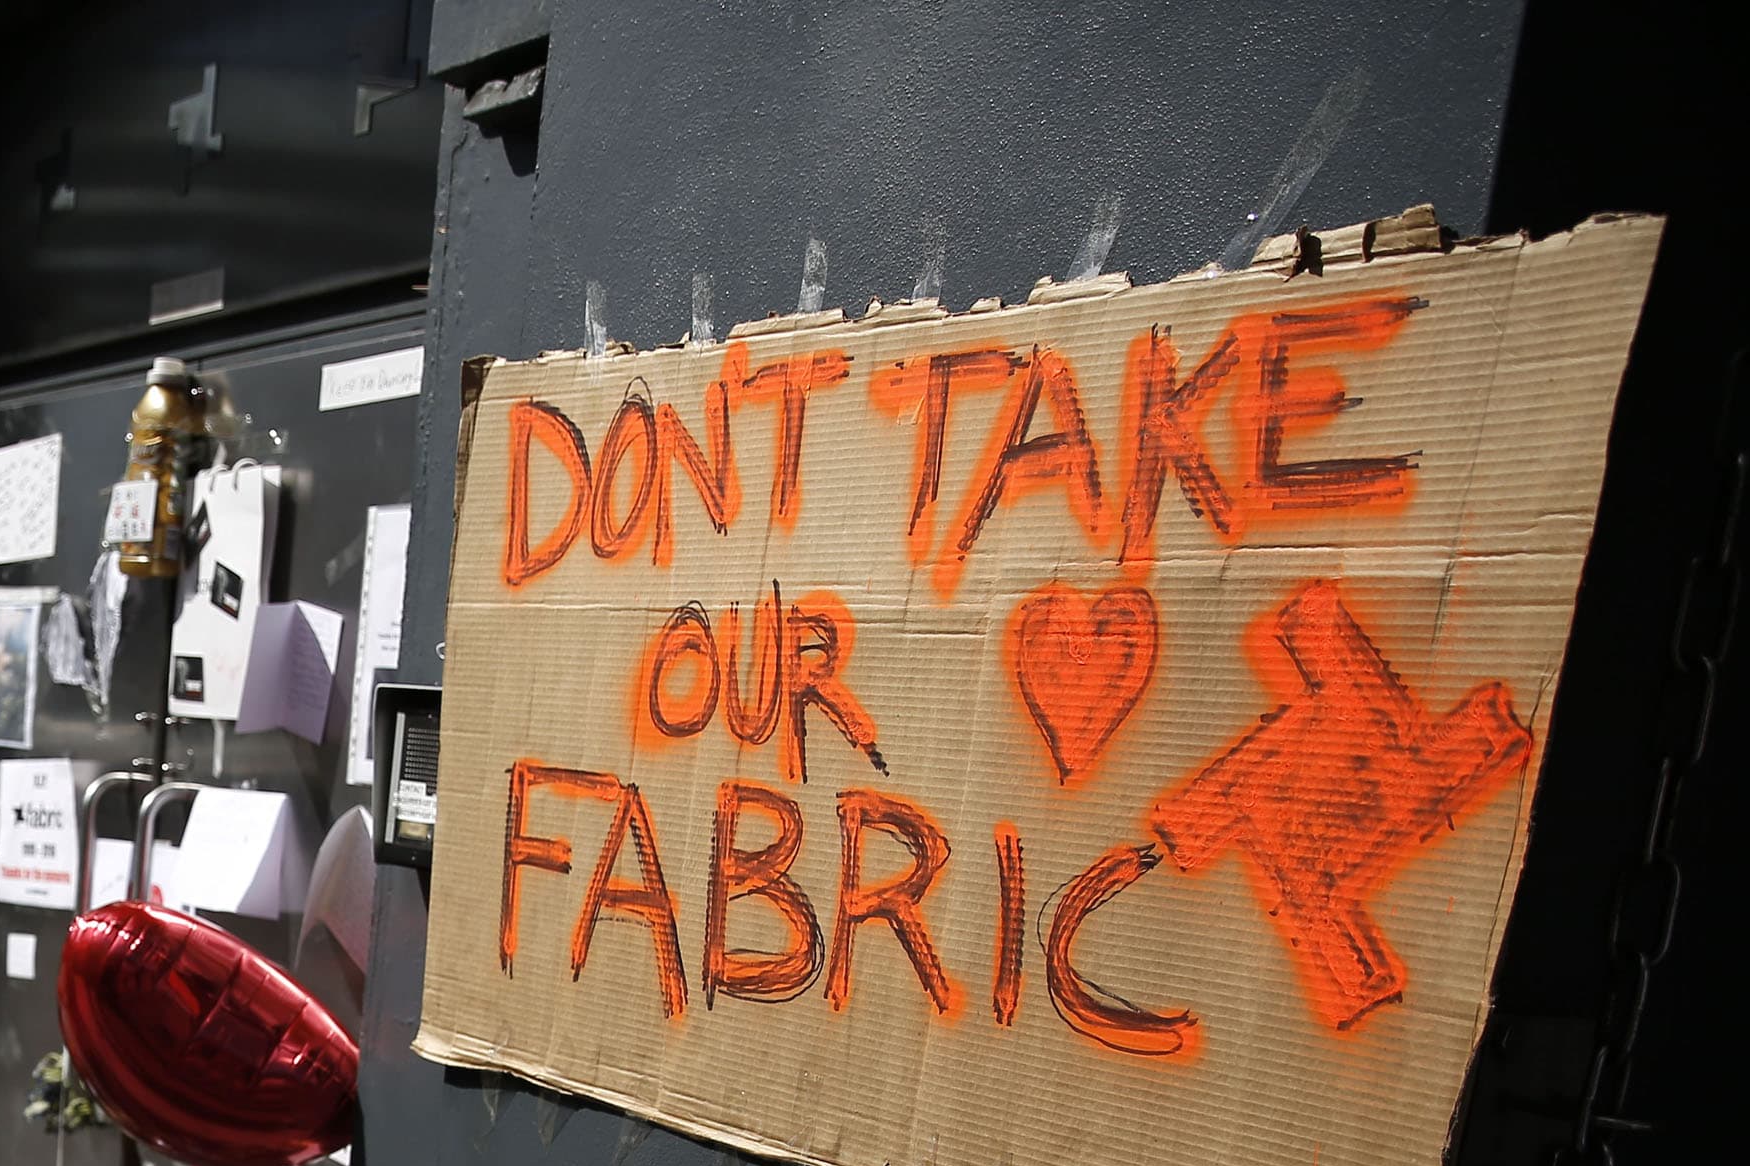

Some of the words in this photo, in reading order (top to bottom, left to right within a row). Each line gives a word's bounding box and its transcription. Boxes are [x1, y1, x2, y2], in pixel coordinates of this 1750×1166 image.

[502, 340, 854, 588] DON'T
[866, 292, 1432, 596] TAKE
[635, 575, 892, 785] OUR
[495, 758, 1205, 1062] FABRIC
